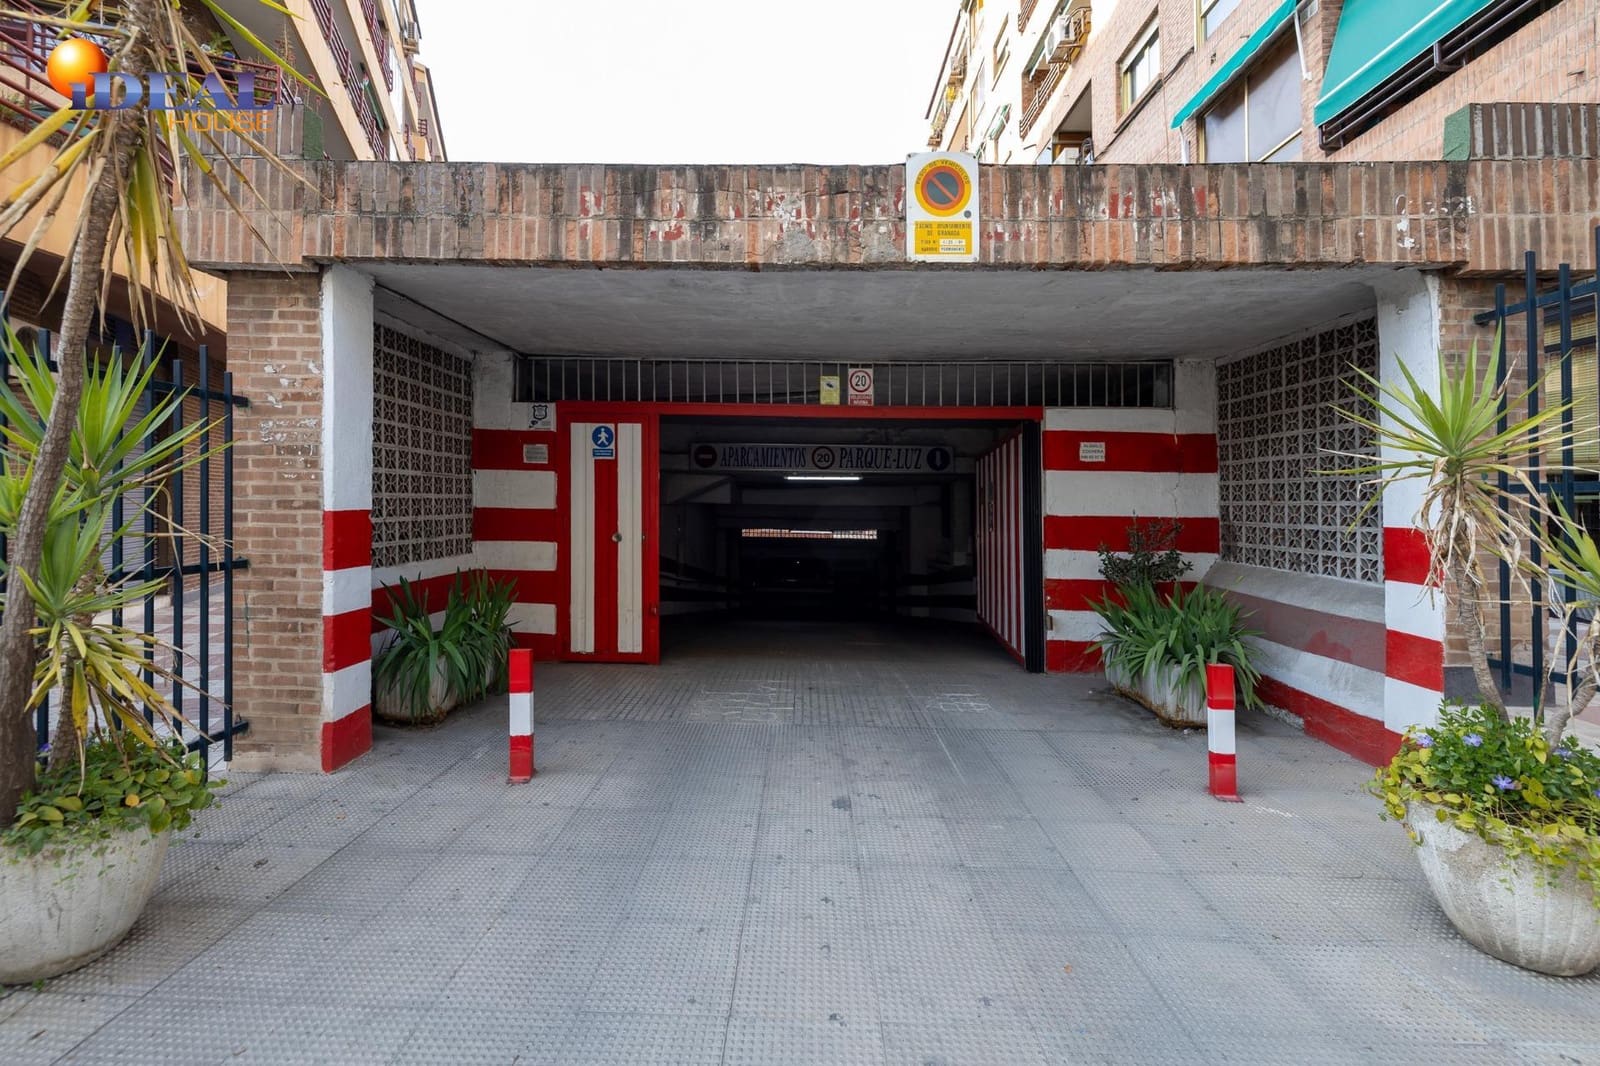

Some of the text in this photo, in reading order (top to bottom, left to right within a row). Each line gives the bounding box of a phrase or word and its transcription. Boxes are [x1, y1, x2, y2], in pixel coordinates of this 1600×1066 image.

[855, 375, 867, 387] 20
[720, 446, 922, 470] APARCAMIENTOS 20 PARQUE-LUZ
